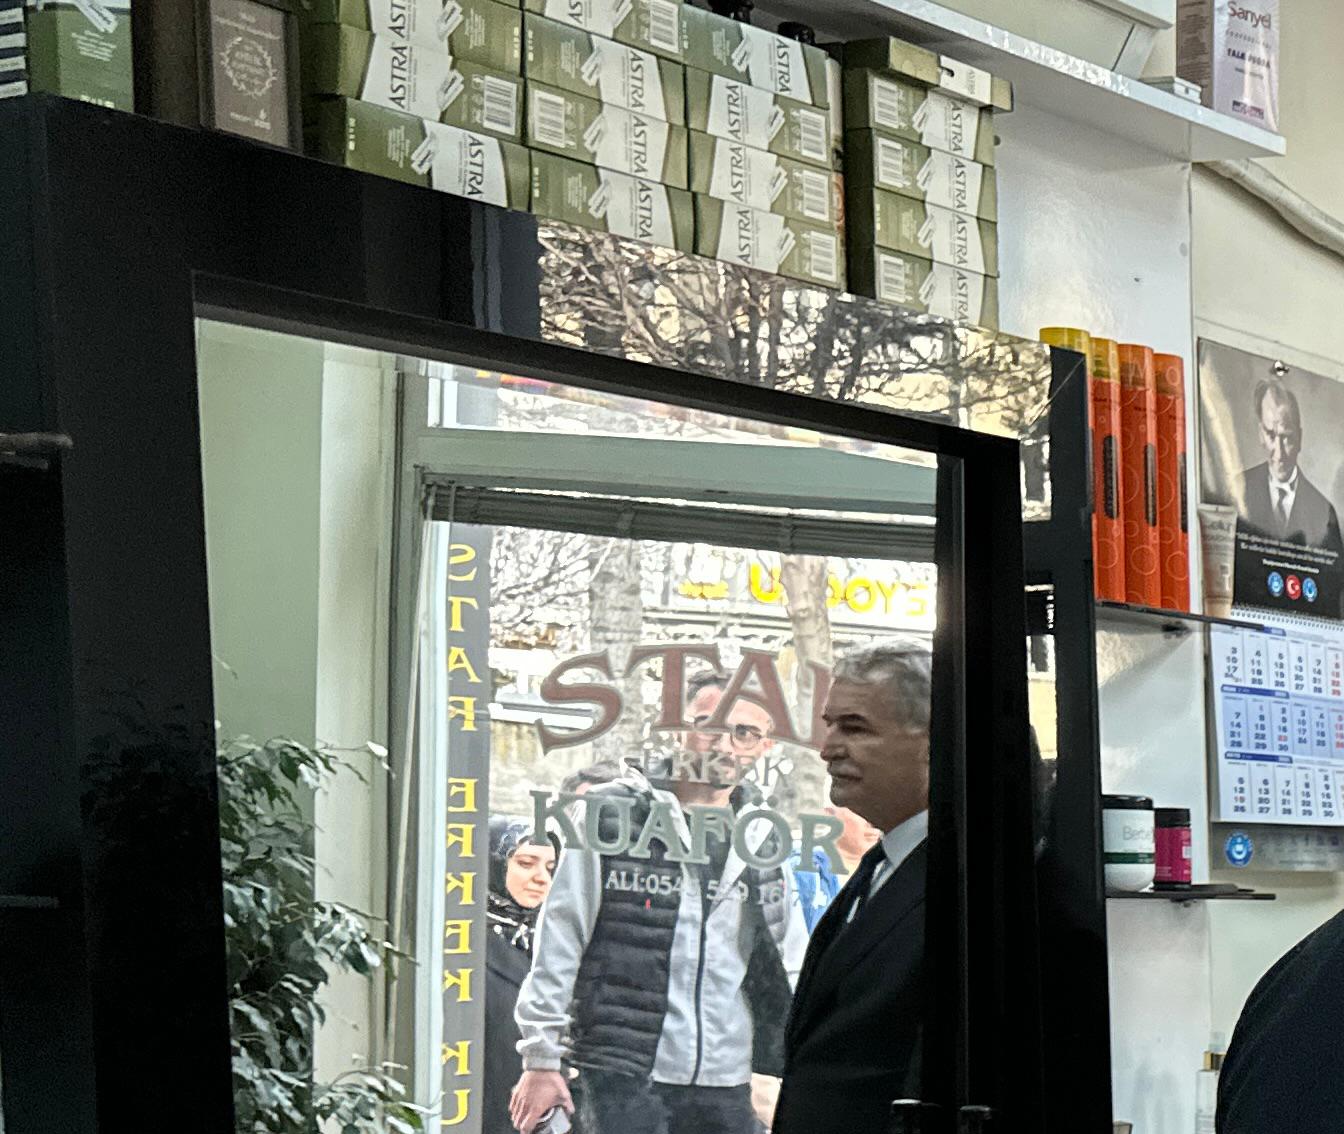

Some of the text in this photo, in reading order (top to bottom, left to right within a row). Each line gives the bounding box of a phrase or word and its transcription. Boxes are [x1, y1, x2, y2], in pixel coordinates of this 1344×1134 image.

[388, 42, 407, 109] ASTRA
[630, 51, 644, 114] ASTRA
[776, 38, 791, 95] ASTRA
[726, 83, 742, 141] ASTRA
[951, 103, 963, 154] ASTRA
[468, 135, 484, 197] ASTRA
[633, 116, 648, 174] ASTRA
[730, 144, 743, 202] ASTRA
[638, 181, 653, 240] ASTRA
[952, 159, 967, 212] ASTRA
[738, 209, 751, 265] ASTRA
[955, 214, 969, 270] ASTRA
[956, 271, 969, 326] ASTRA
[529, 789, 849, 875] KUAFÖR
